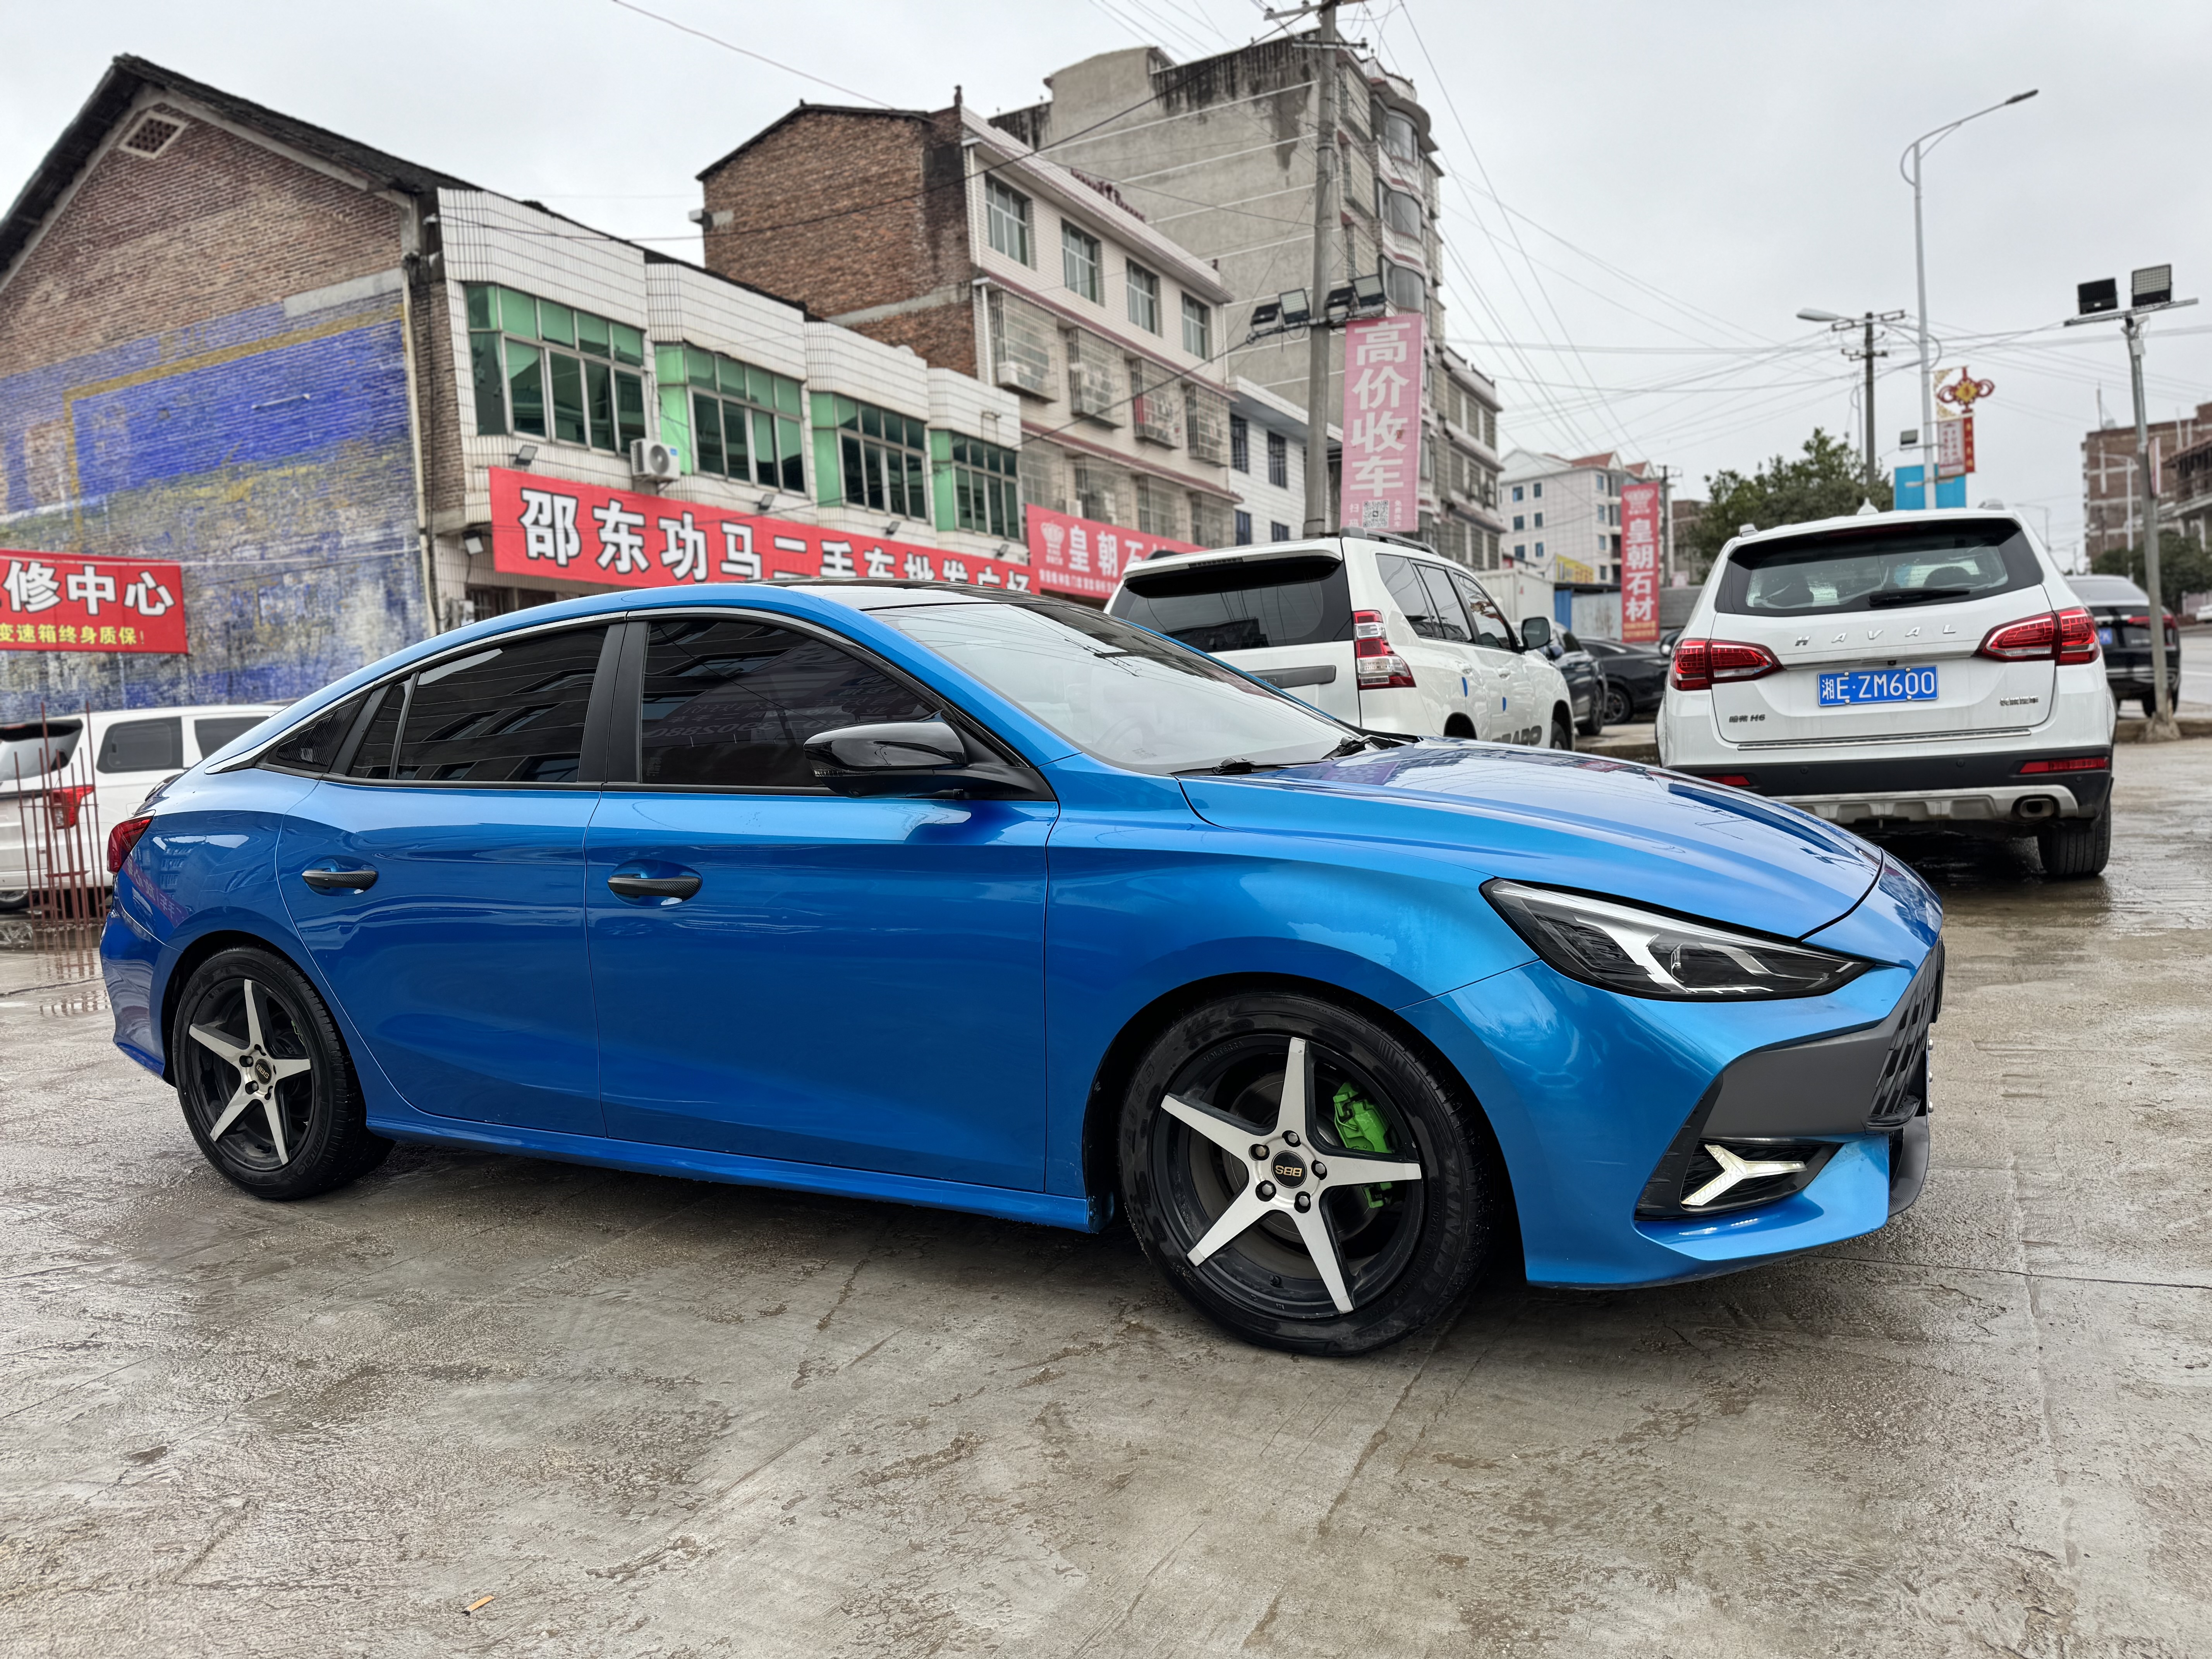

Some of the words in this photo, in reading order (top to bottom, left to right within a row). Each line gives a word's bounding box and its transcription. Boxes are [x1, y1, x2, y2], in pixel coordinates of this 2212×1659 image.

[1349, 321, 1411, 497] 高价收车
[1626, 518, 1655, 622] 皇朝石材
[1795, 624, 1957, 647] HAVAL
[1750, 713, 1766, 722] H6
[1491, 725, 1542, 745] RADO
[256, 1064, 270, 1079] BBS
[1274, 1164, 1303, 1178] BBS
